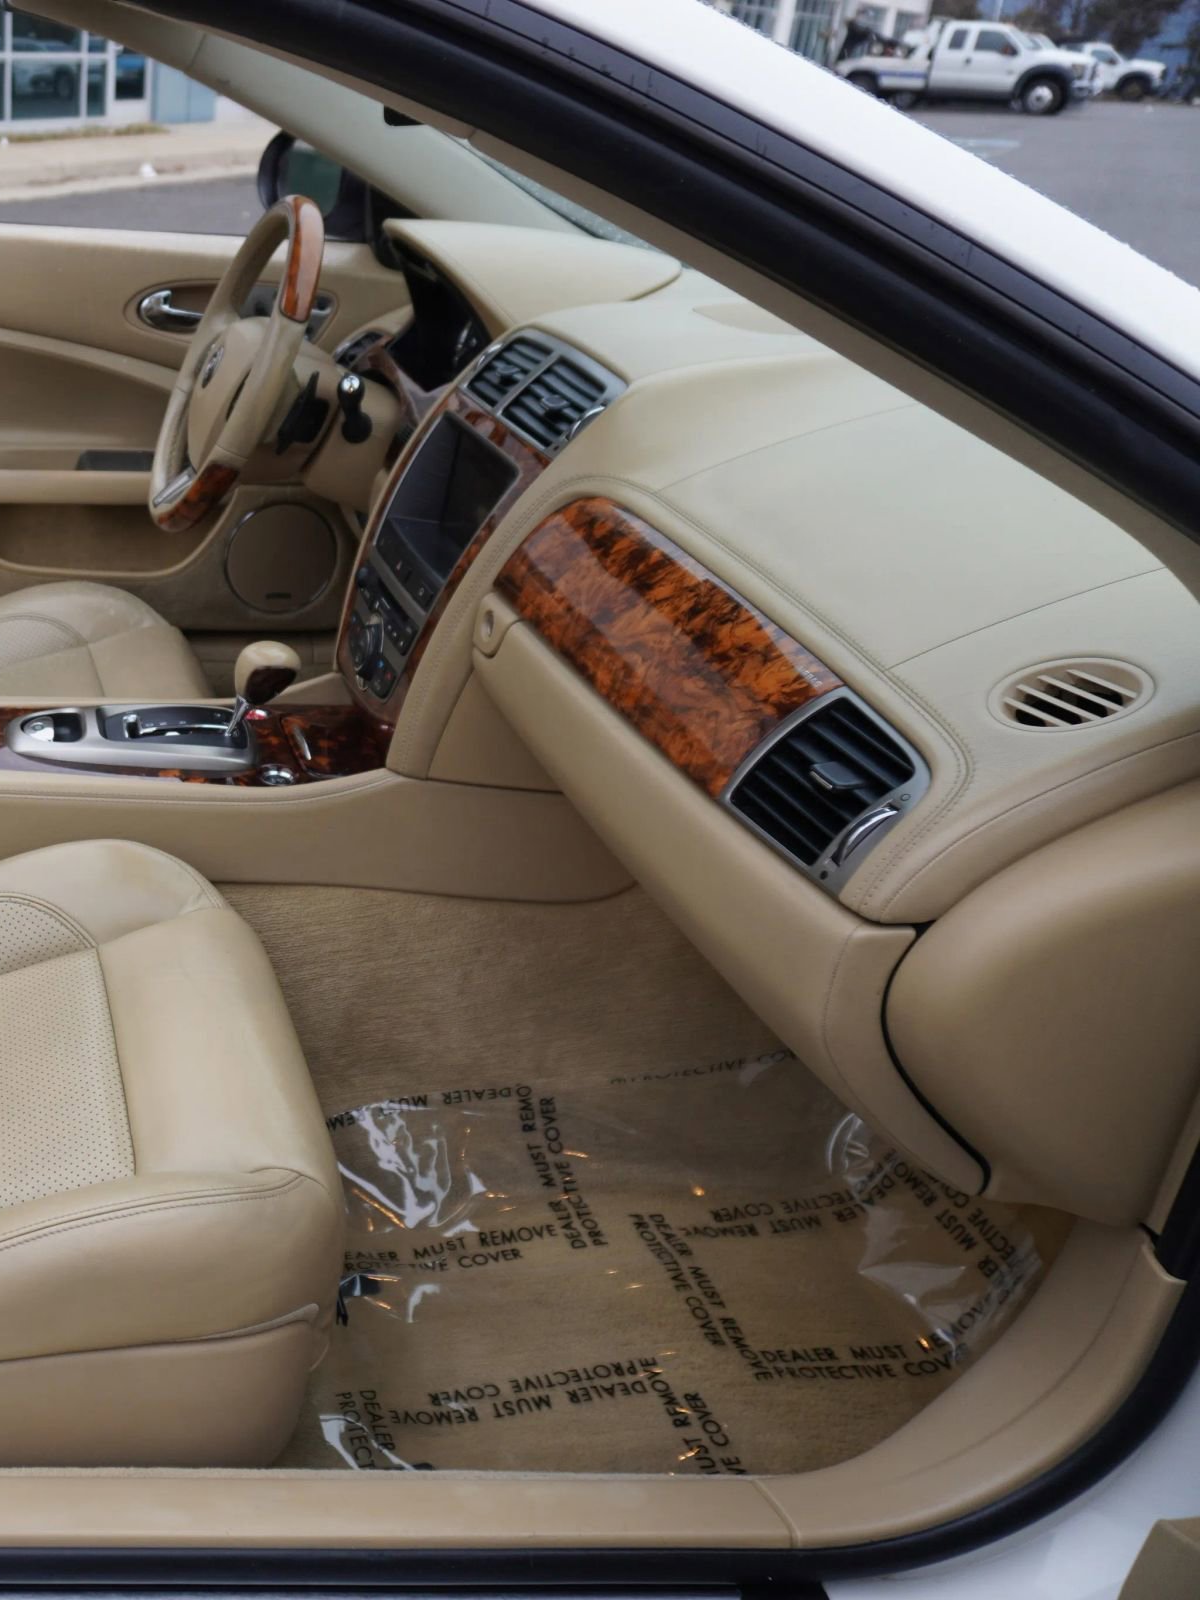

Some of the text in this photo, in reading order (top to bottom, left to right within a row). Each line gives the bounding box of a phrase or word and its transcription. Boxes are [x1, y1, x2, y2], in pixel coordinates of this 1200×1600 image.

[443, 1087, 512, 1105] DEALER
[515, 1084, 588, 1250] DEALER MUST REMO
[539, 1096, 609, 1247] PROTECTIVE COVER
[680, 1223, 760, 1238] REMOVE
[709, 1202, 774, 1224] COVER
[769, 1214, 822, 1234] MUST
[935, 1208, 977, 1251] MUST
[344, 1224, 559, 1262] EALER MUST REMOVE
[458, 1248, 523, 1269] COVER
[628, 1213, 727, 1347] PROTECTIVE COVER
[649, 1213, 774, 1381] DEALER MUST REMOVE
[762, 1347, 839, 1364] DEALER
[851, 1343, 908, 1360] MUST
[776, 1363, 898, 1381] PROTECTIVE
[388, 1380, 649, 1425] DEALER MUST REMOVE
[427, 1360, 639, 1407] PROTECTIVE COVER
[335, 1391, 376, 1469] PROTECT
[360, 1390, 397, 1453] DEALER
[639, 1357, 720, 1475] UST REMOVE
[683, 1392, 730, 1447] COVER
